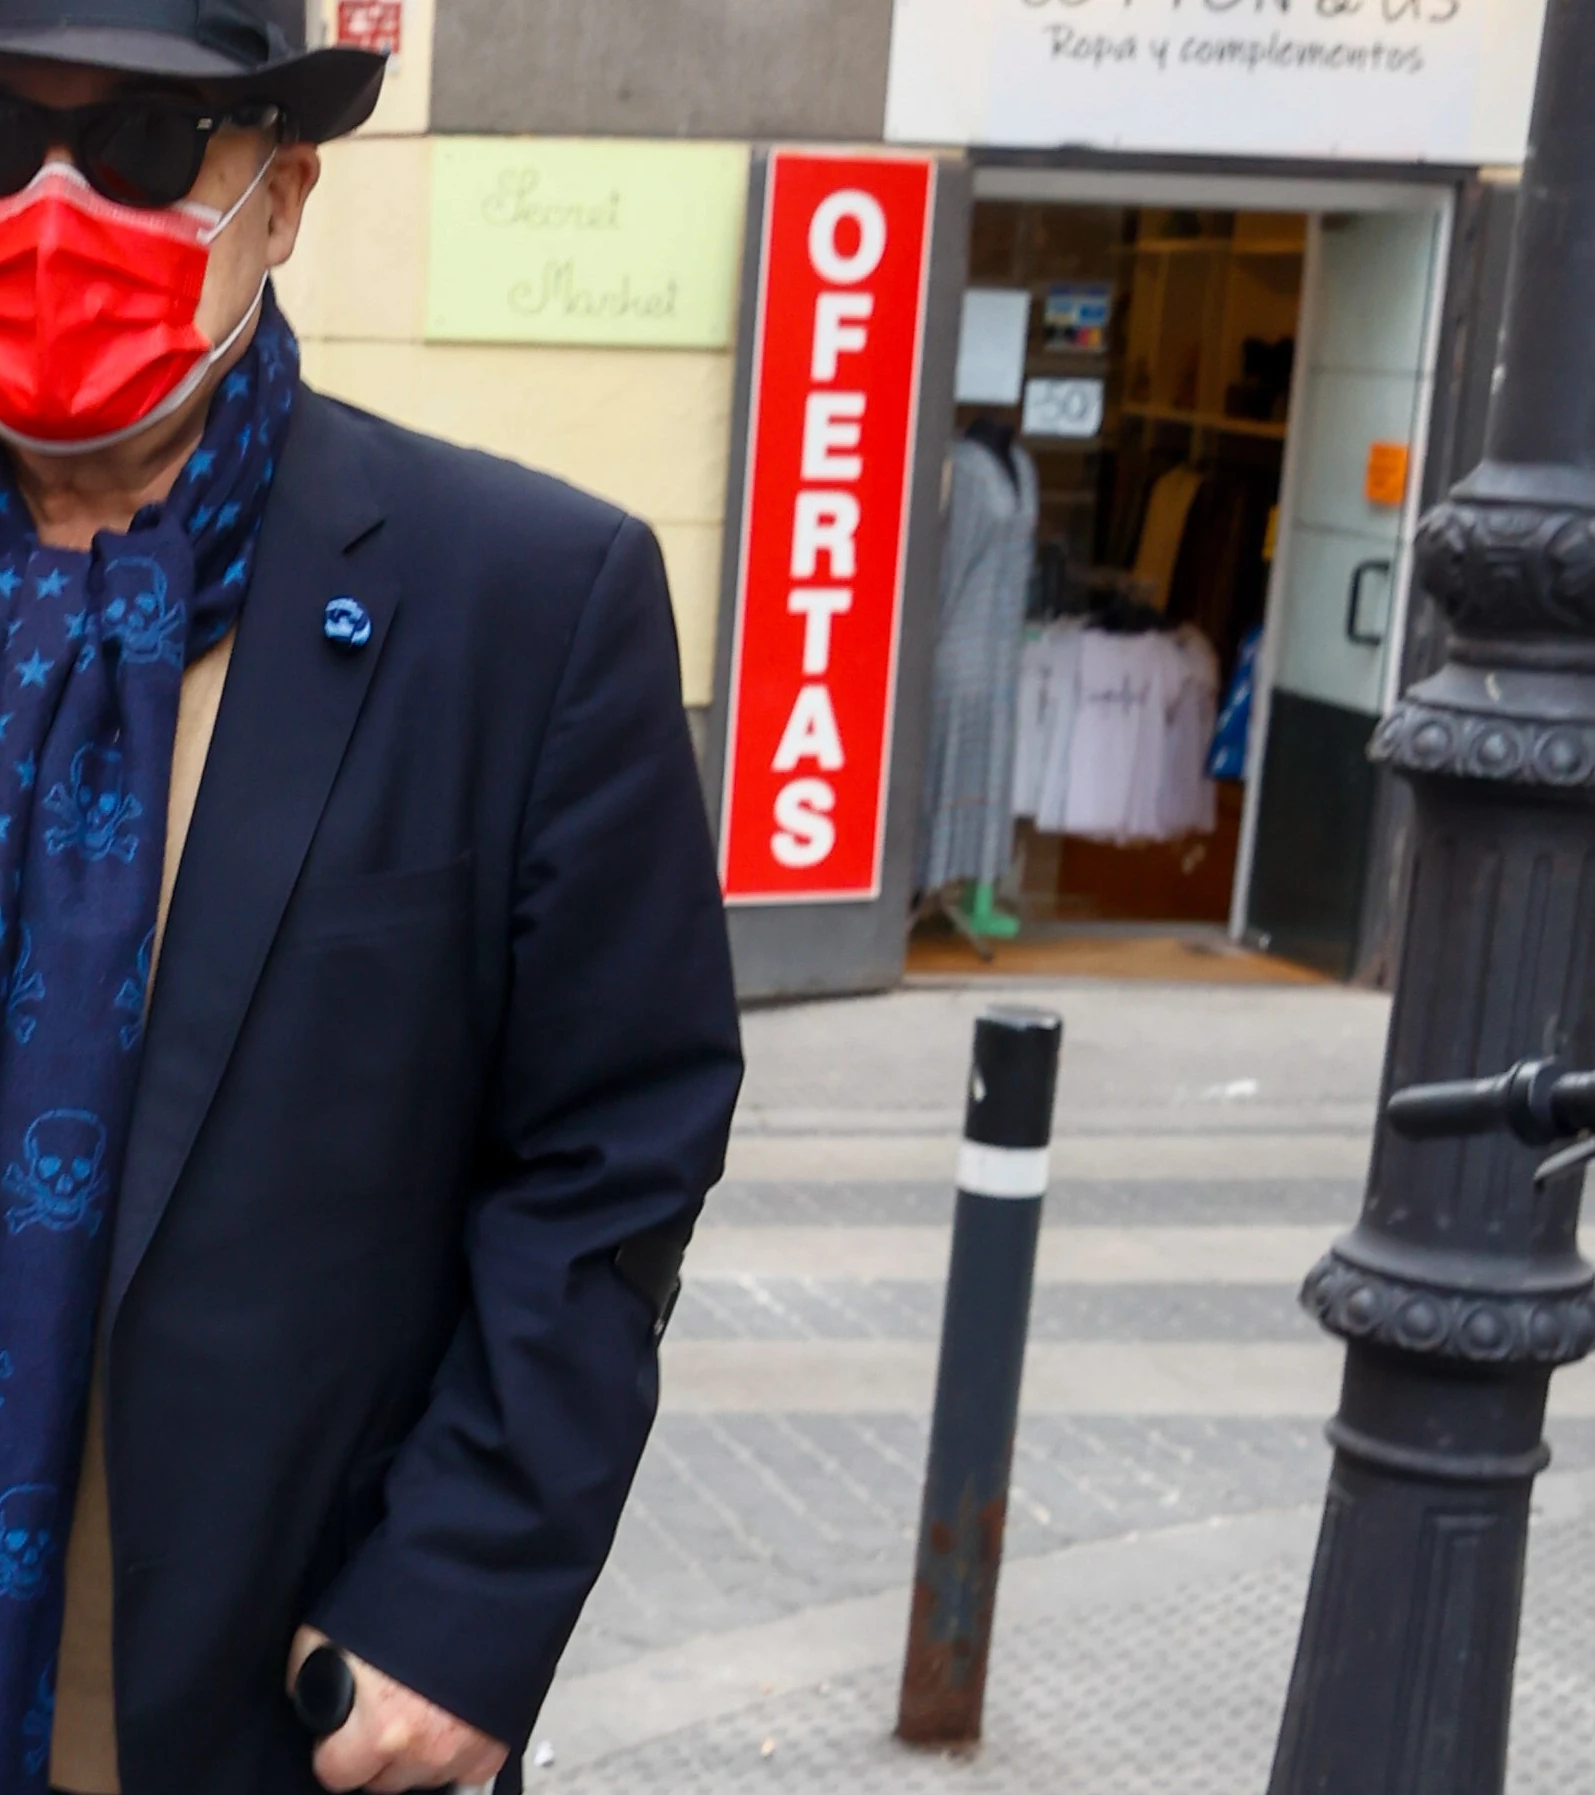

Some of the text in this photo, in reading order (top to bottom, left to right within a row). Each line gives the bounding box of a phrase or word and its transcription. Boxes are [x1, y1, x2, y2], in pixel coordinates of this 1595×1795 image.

[1043, 23, 1425, 74] Ropa y complementos
[481, 165, 620, 231] Secret
[506, 256, 677, 319] Market
[770, 189, 886, 868] OFERTAS
